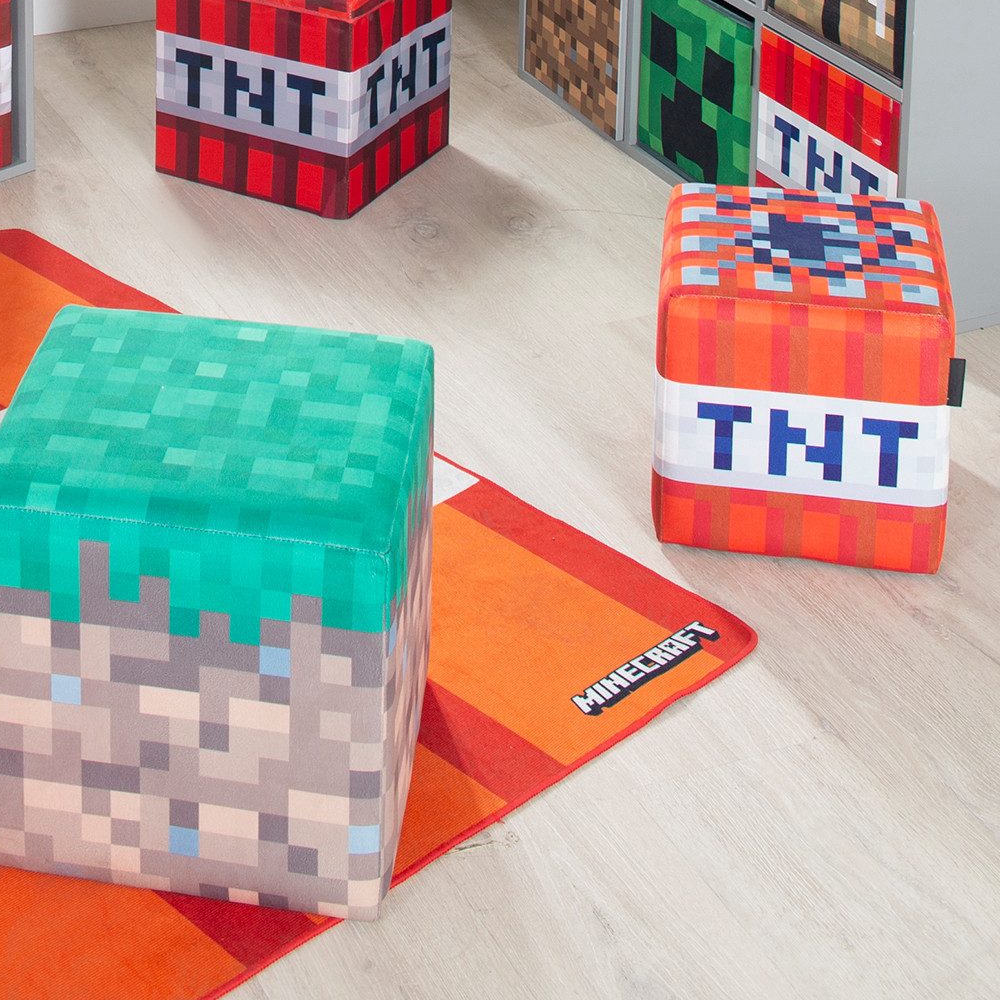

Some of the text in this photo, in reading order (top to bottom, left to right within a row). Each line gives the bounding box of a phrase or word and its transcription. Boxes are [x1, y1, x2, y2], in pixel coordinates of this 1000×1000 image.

[175, 47, 326, 136] TNT
[366, 26, 447, 129] TNT
[773, 114, 880, 196] TNT
[696, 401, 920, 489] TNT
[571, 620, 720, 716] MINECRAFT
